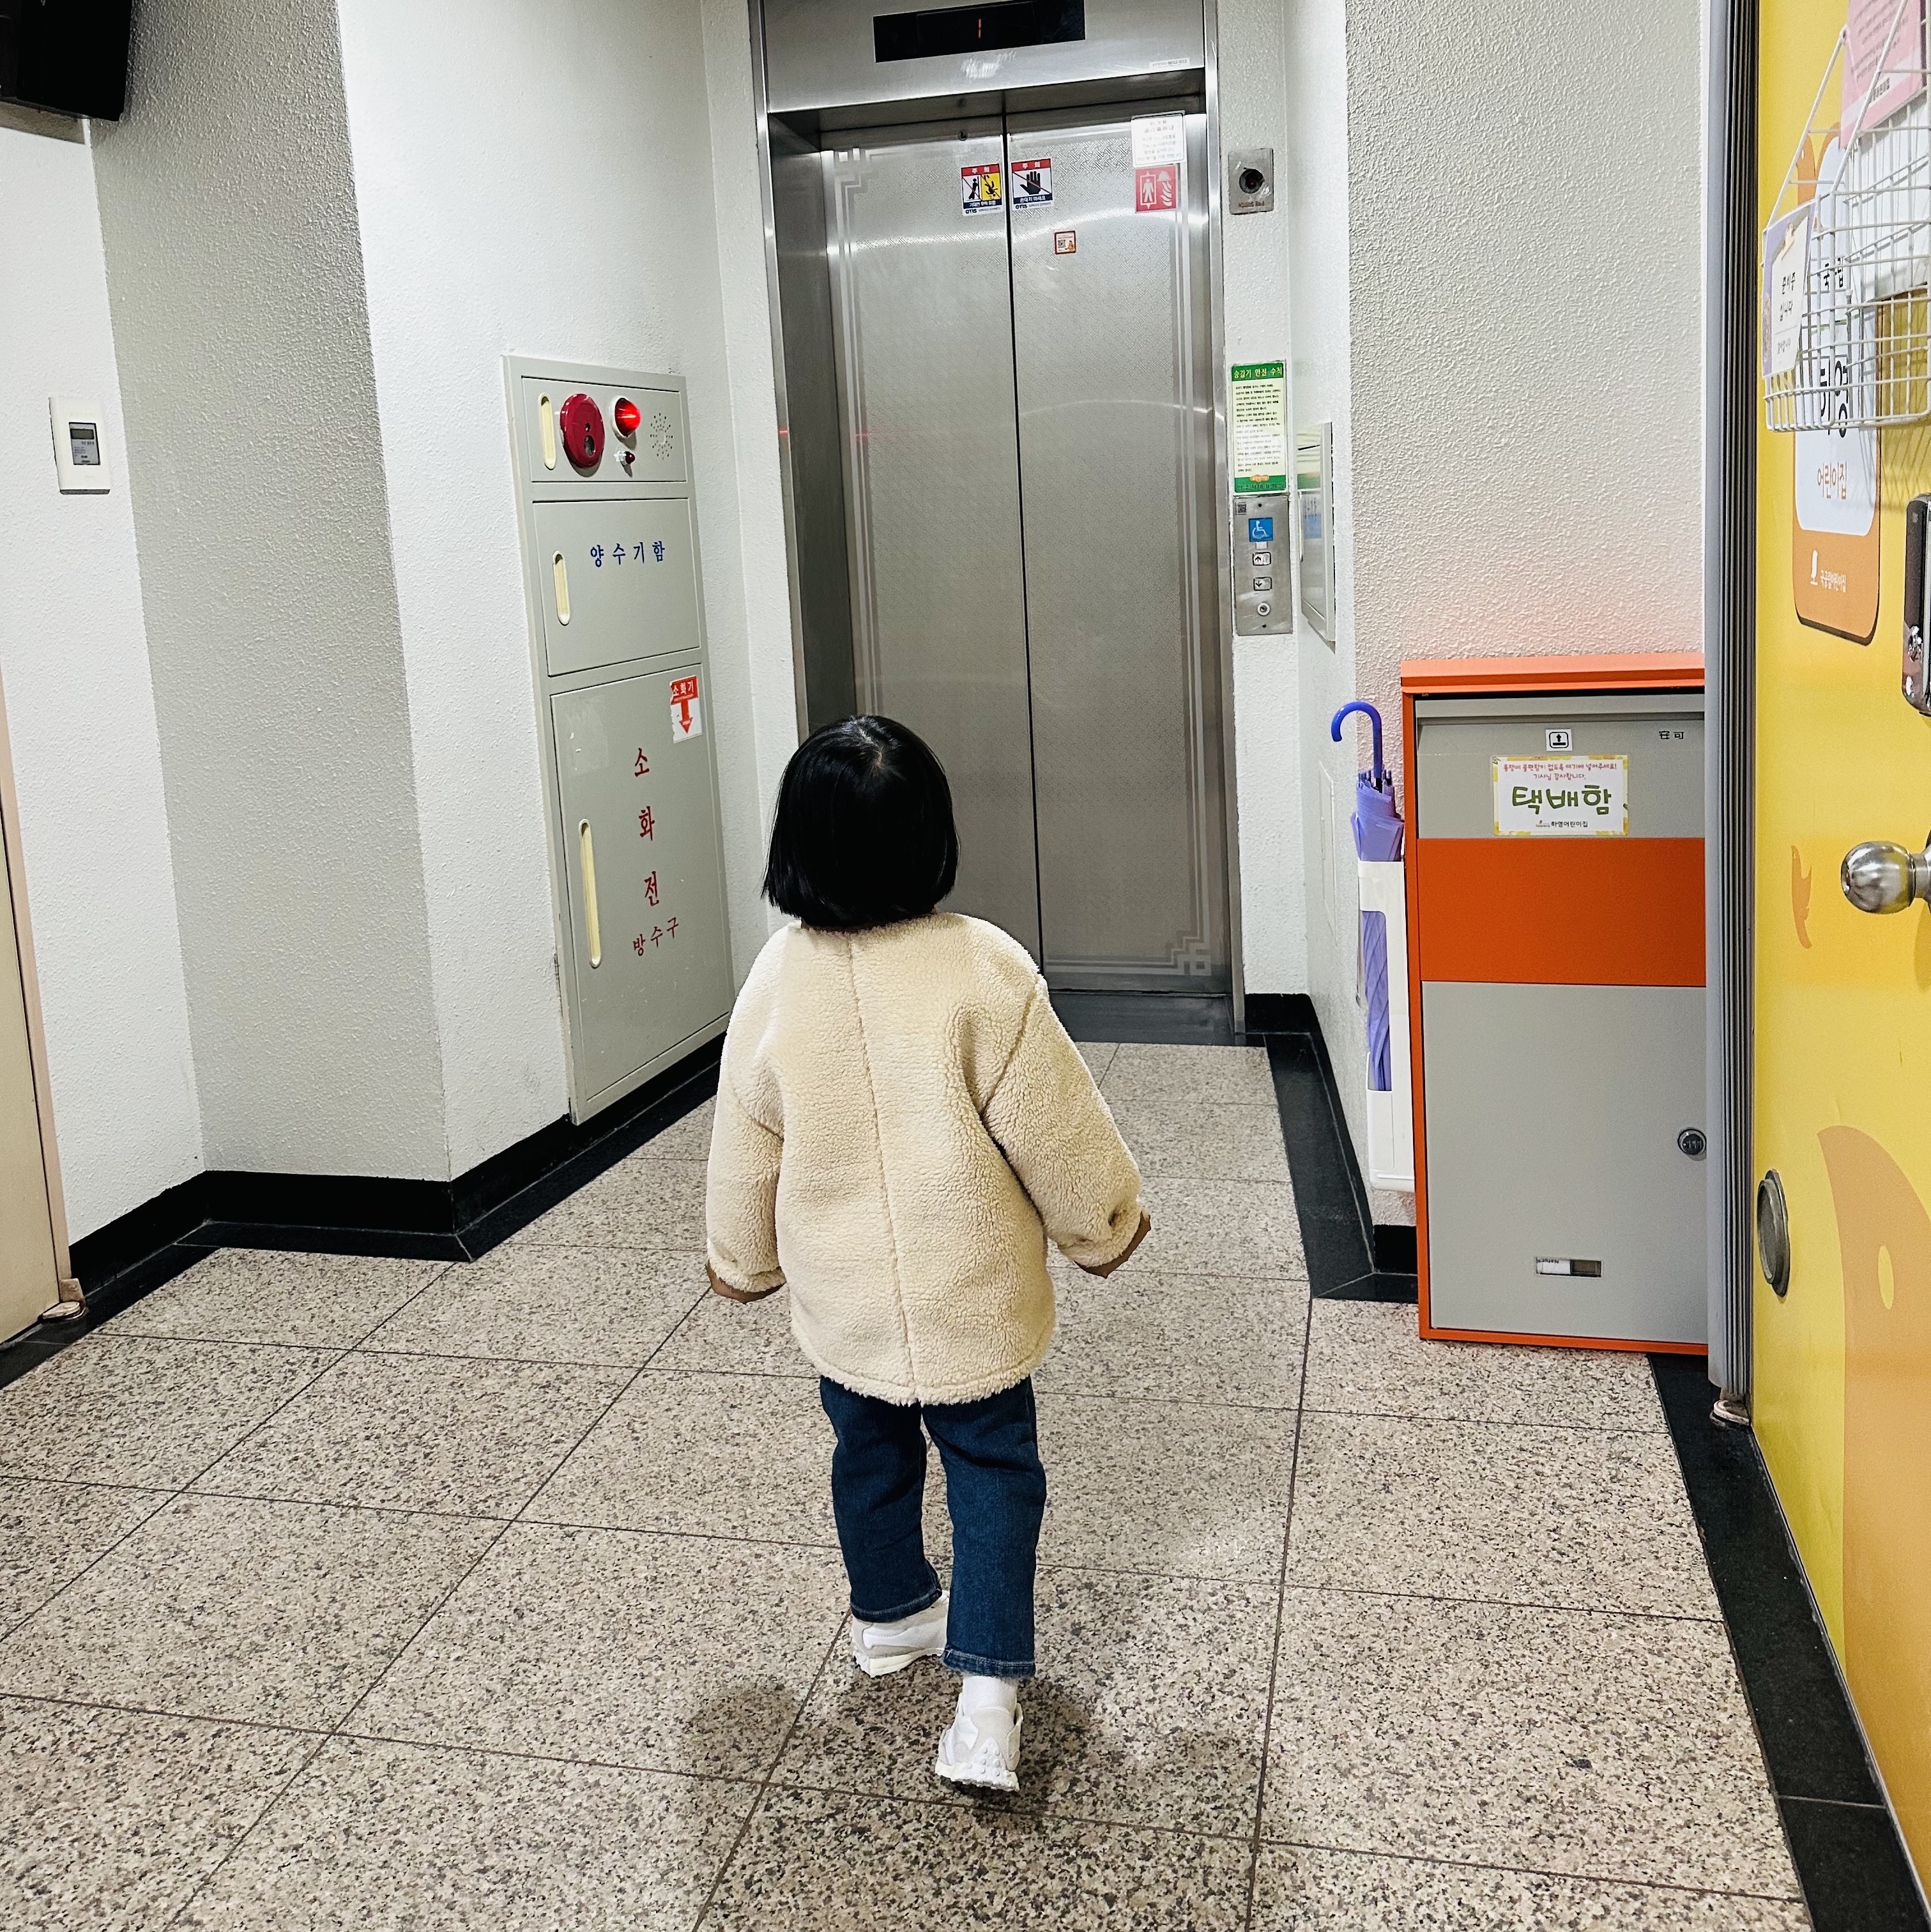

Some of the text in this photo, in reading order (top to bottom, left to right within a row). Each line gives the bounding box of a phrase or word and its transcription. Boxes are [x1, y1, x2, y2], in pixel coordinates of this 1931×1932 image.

[978, 18, 982, 39] 1
[1233, 369, 1252, 379] 승강기
[1817, 462, 1847, 499] 어린이집
[590, 540, 666, 568] 양수기함
[673, 679, 694, 696] 소화기
[1523, 763, 1546, 772] 불편함이
[1548, 763, 1564, 772] 없도록
[1512, 784, 1612, 815] 택배함
[632, 917, 679, 956] 방수구
